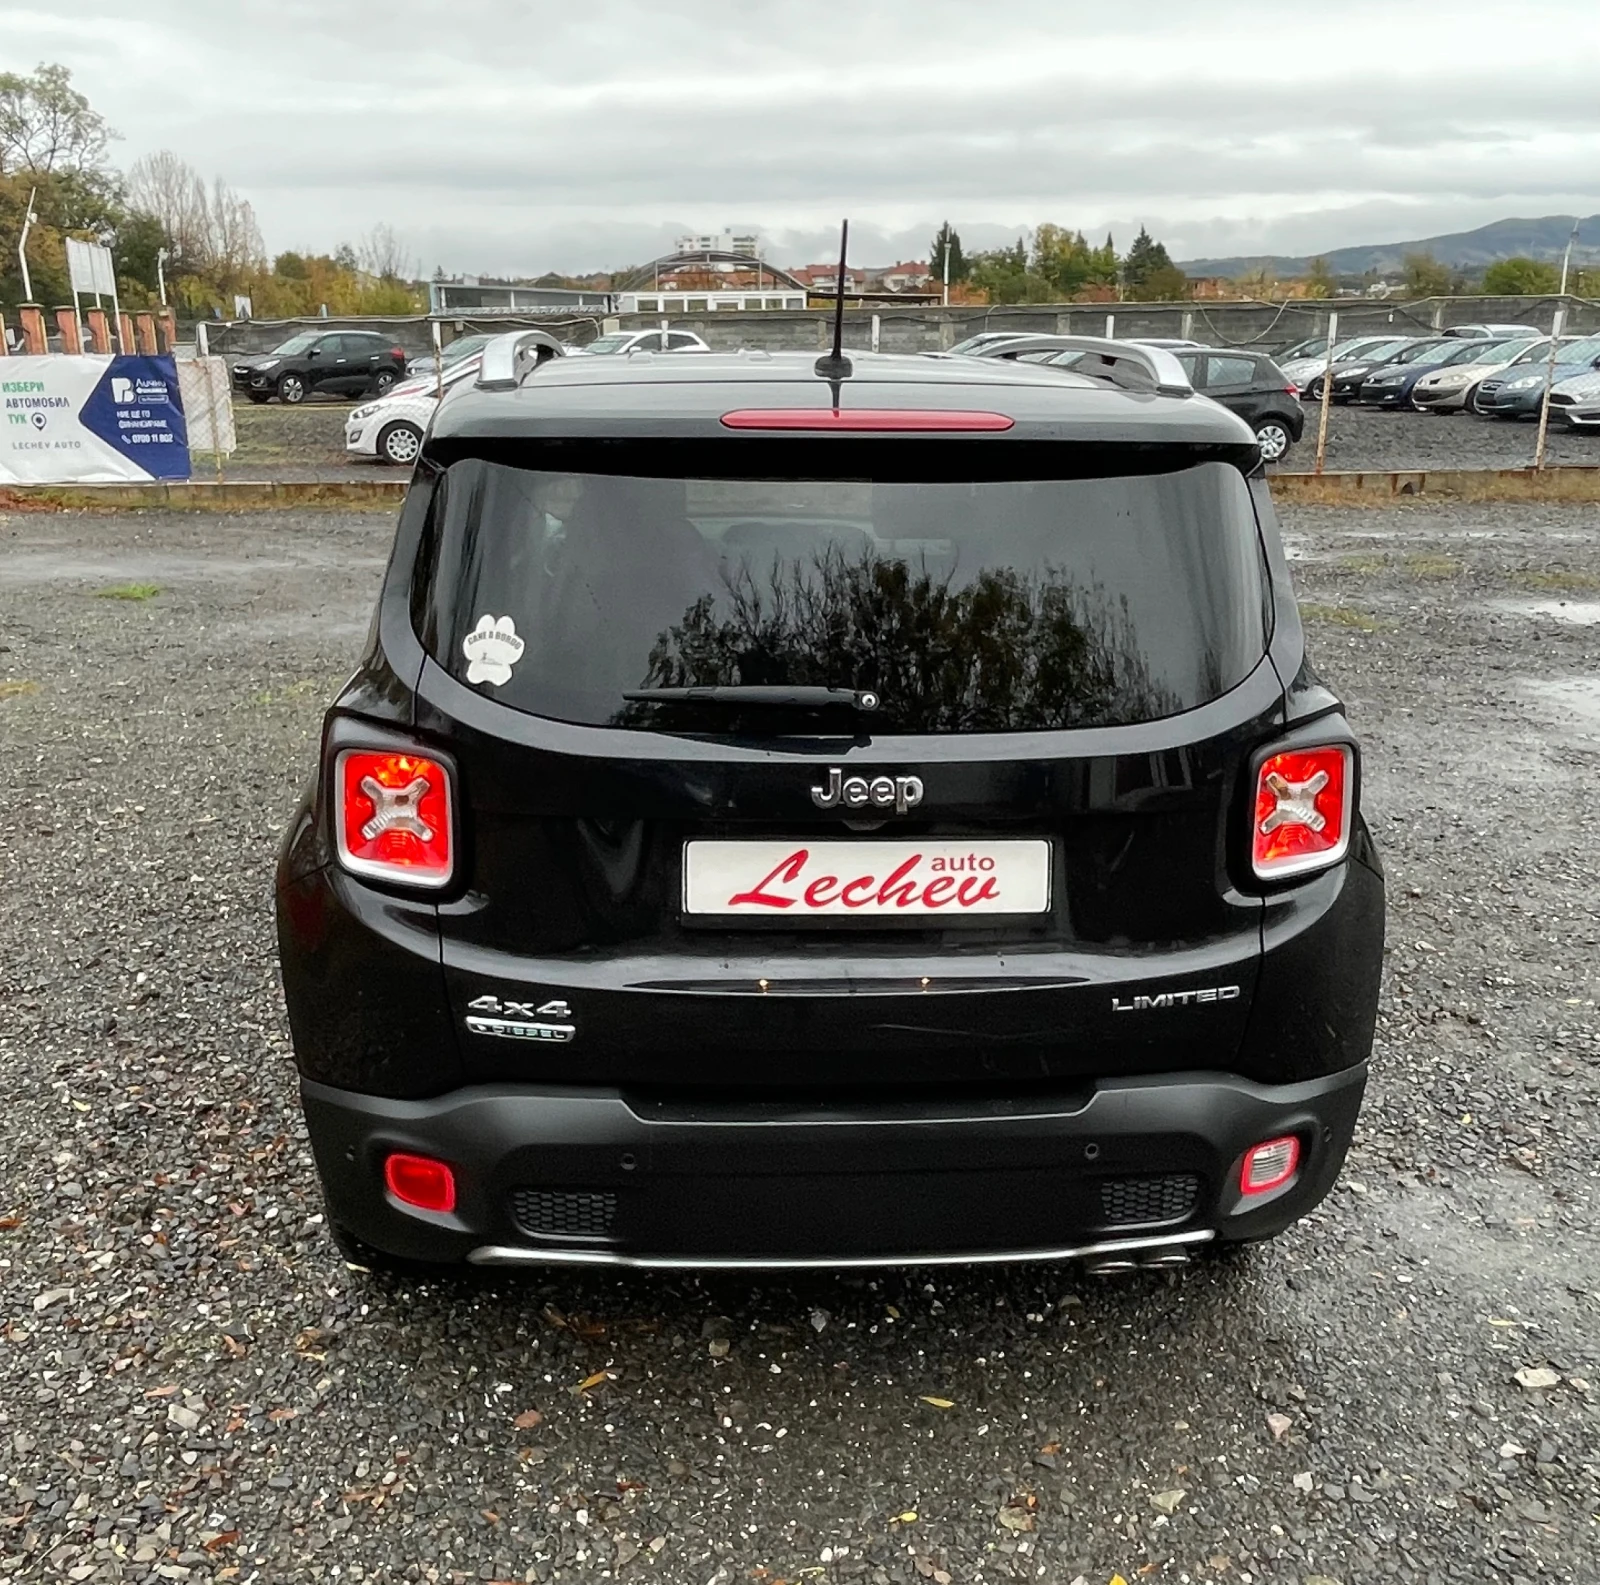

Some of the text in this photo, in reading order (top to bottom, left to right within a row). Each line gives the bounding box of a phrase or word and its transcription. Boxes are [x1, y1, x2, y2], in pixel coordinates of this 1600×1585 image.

[2, 382, 45, 393] ИЗБЕРИ
[6, 397, 70, 408] АВТОМОБИЛ
[8, 414, 27, 424] ТУК
[811, 768, 923, 815] Jeep
[931, 853, 996, 872] auto
[728, 849, 1000, 908] Lechev
[1112, 985, 1240, 1011] LIMITED
